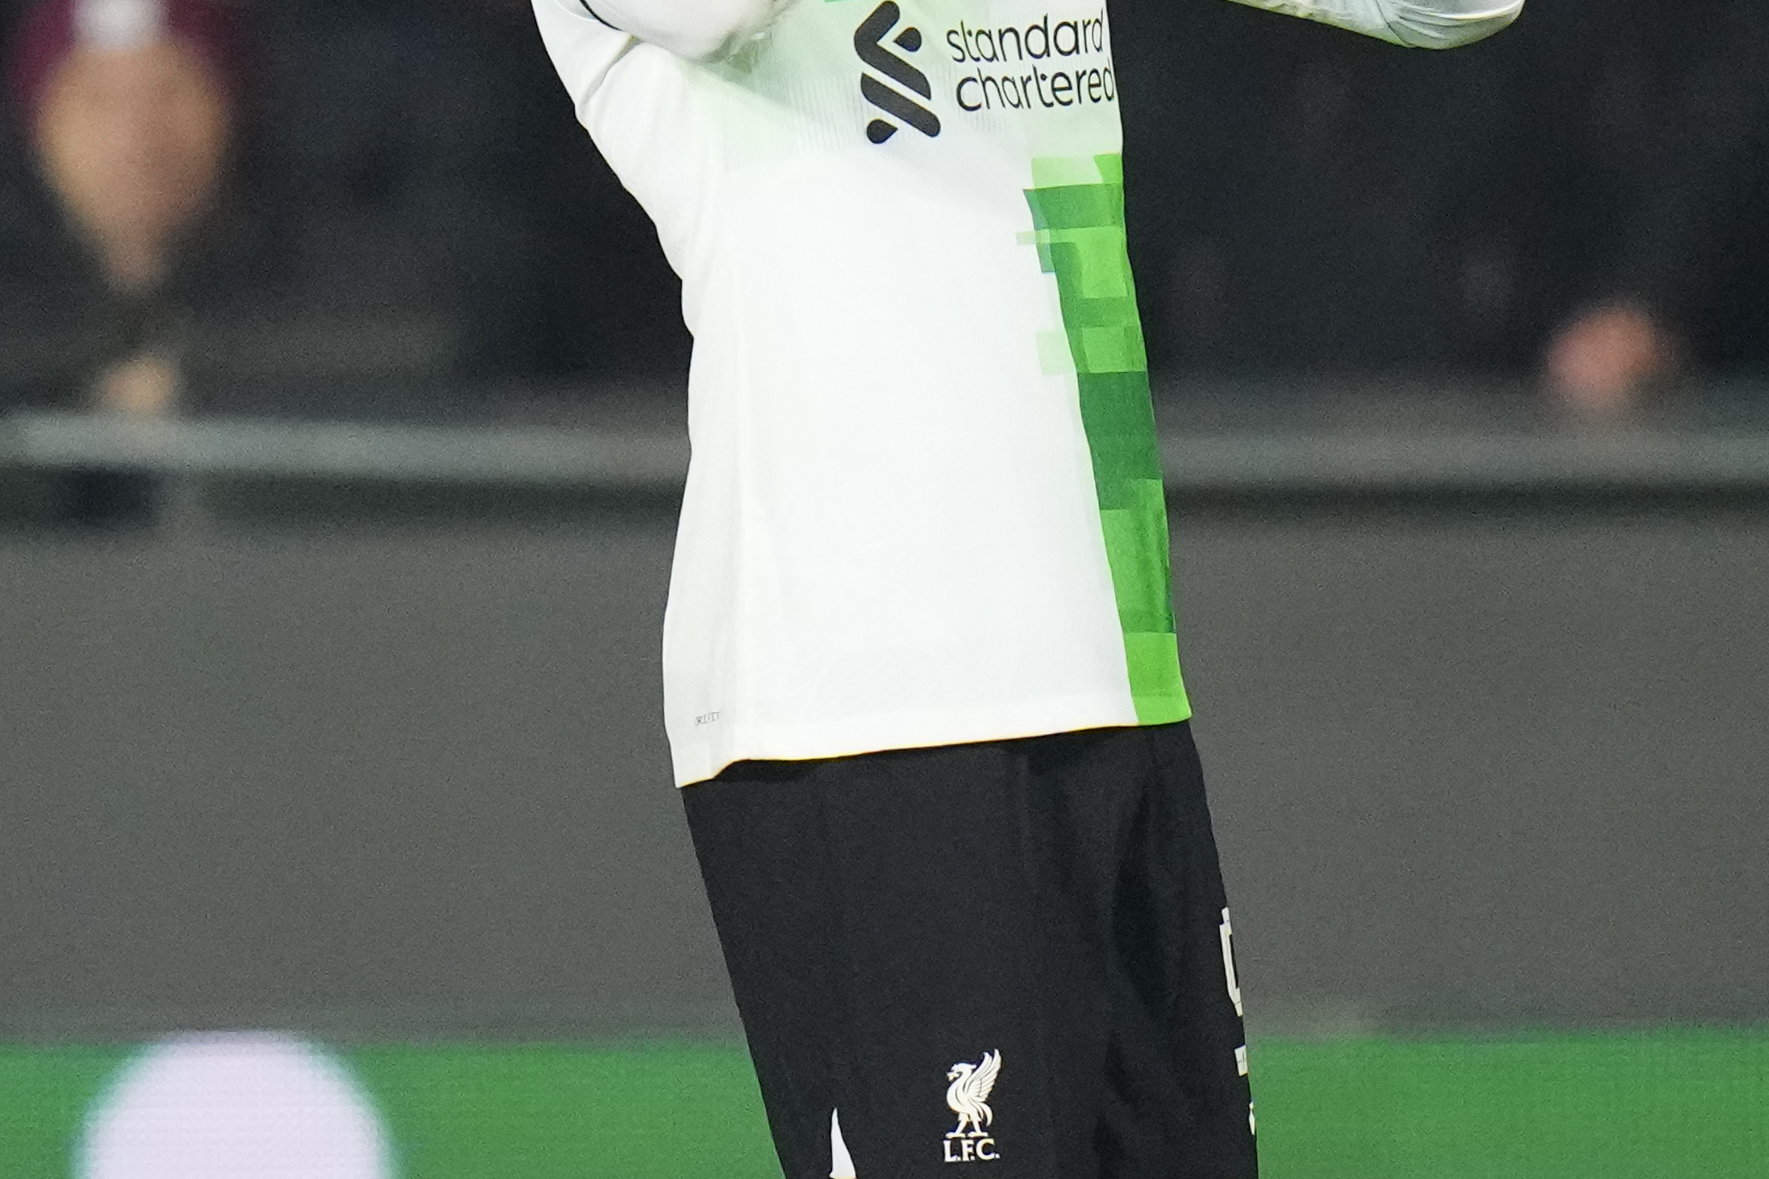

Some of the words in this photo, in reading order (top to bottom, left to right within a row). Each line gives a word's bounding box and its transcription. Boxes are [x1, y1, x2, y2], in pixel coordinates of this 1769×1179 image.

[946, 7, 1104, 63] standard
[956, 57, 1115, 112] chartered
[943, 1138, 1001, 1162] L.F.C.
